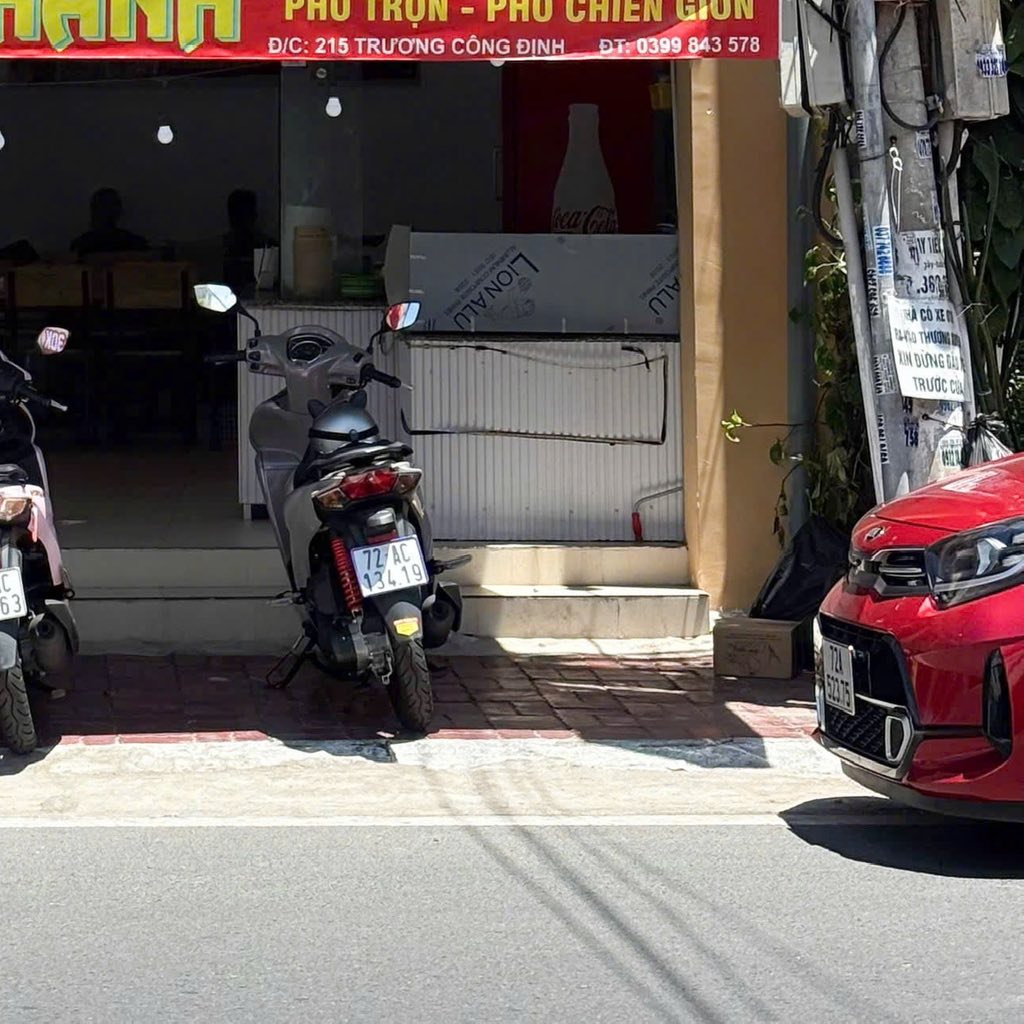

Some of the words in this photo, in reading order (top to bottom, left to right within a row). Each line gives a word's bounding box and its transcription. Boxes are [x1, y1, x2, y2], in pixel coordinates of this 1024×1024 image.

[268, 37, 309, 54] Đ/C:
[315, 37, 349, 55] 215
[354, 36, 446, 55] TRƯƠNG
[451, 34, 511, 55] CÔNG
[599, 38, 631, 53] ĐT:
[636, 37, 683, 54] 0399
[687, 36, 723, 54] 843
[727, 36, 761, 53] 578
[453, 251, 540, 331] LIONALU
[364, 564, 423, 592] 134.19
